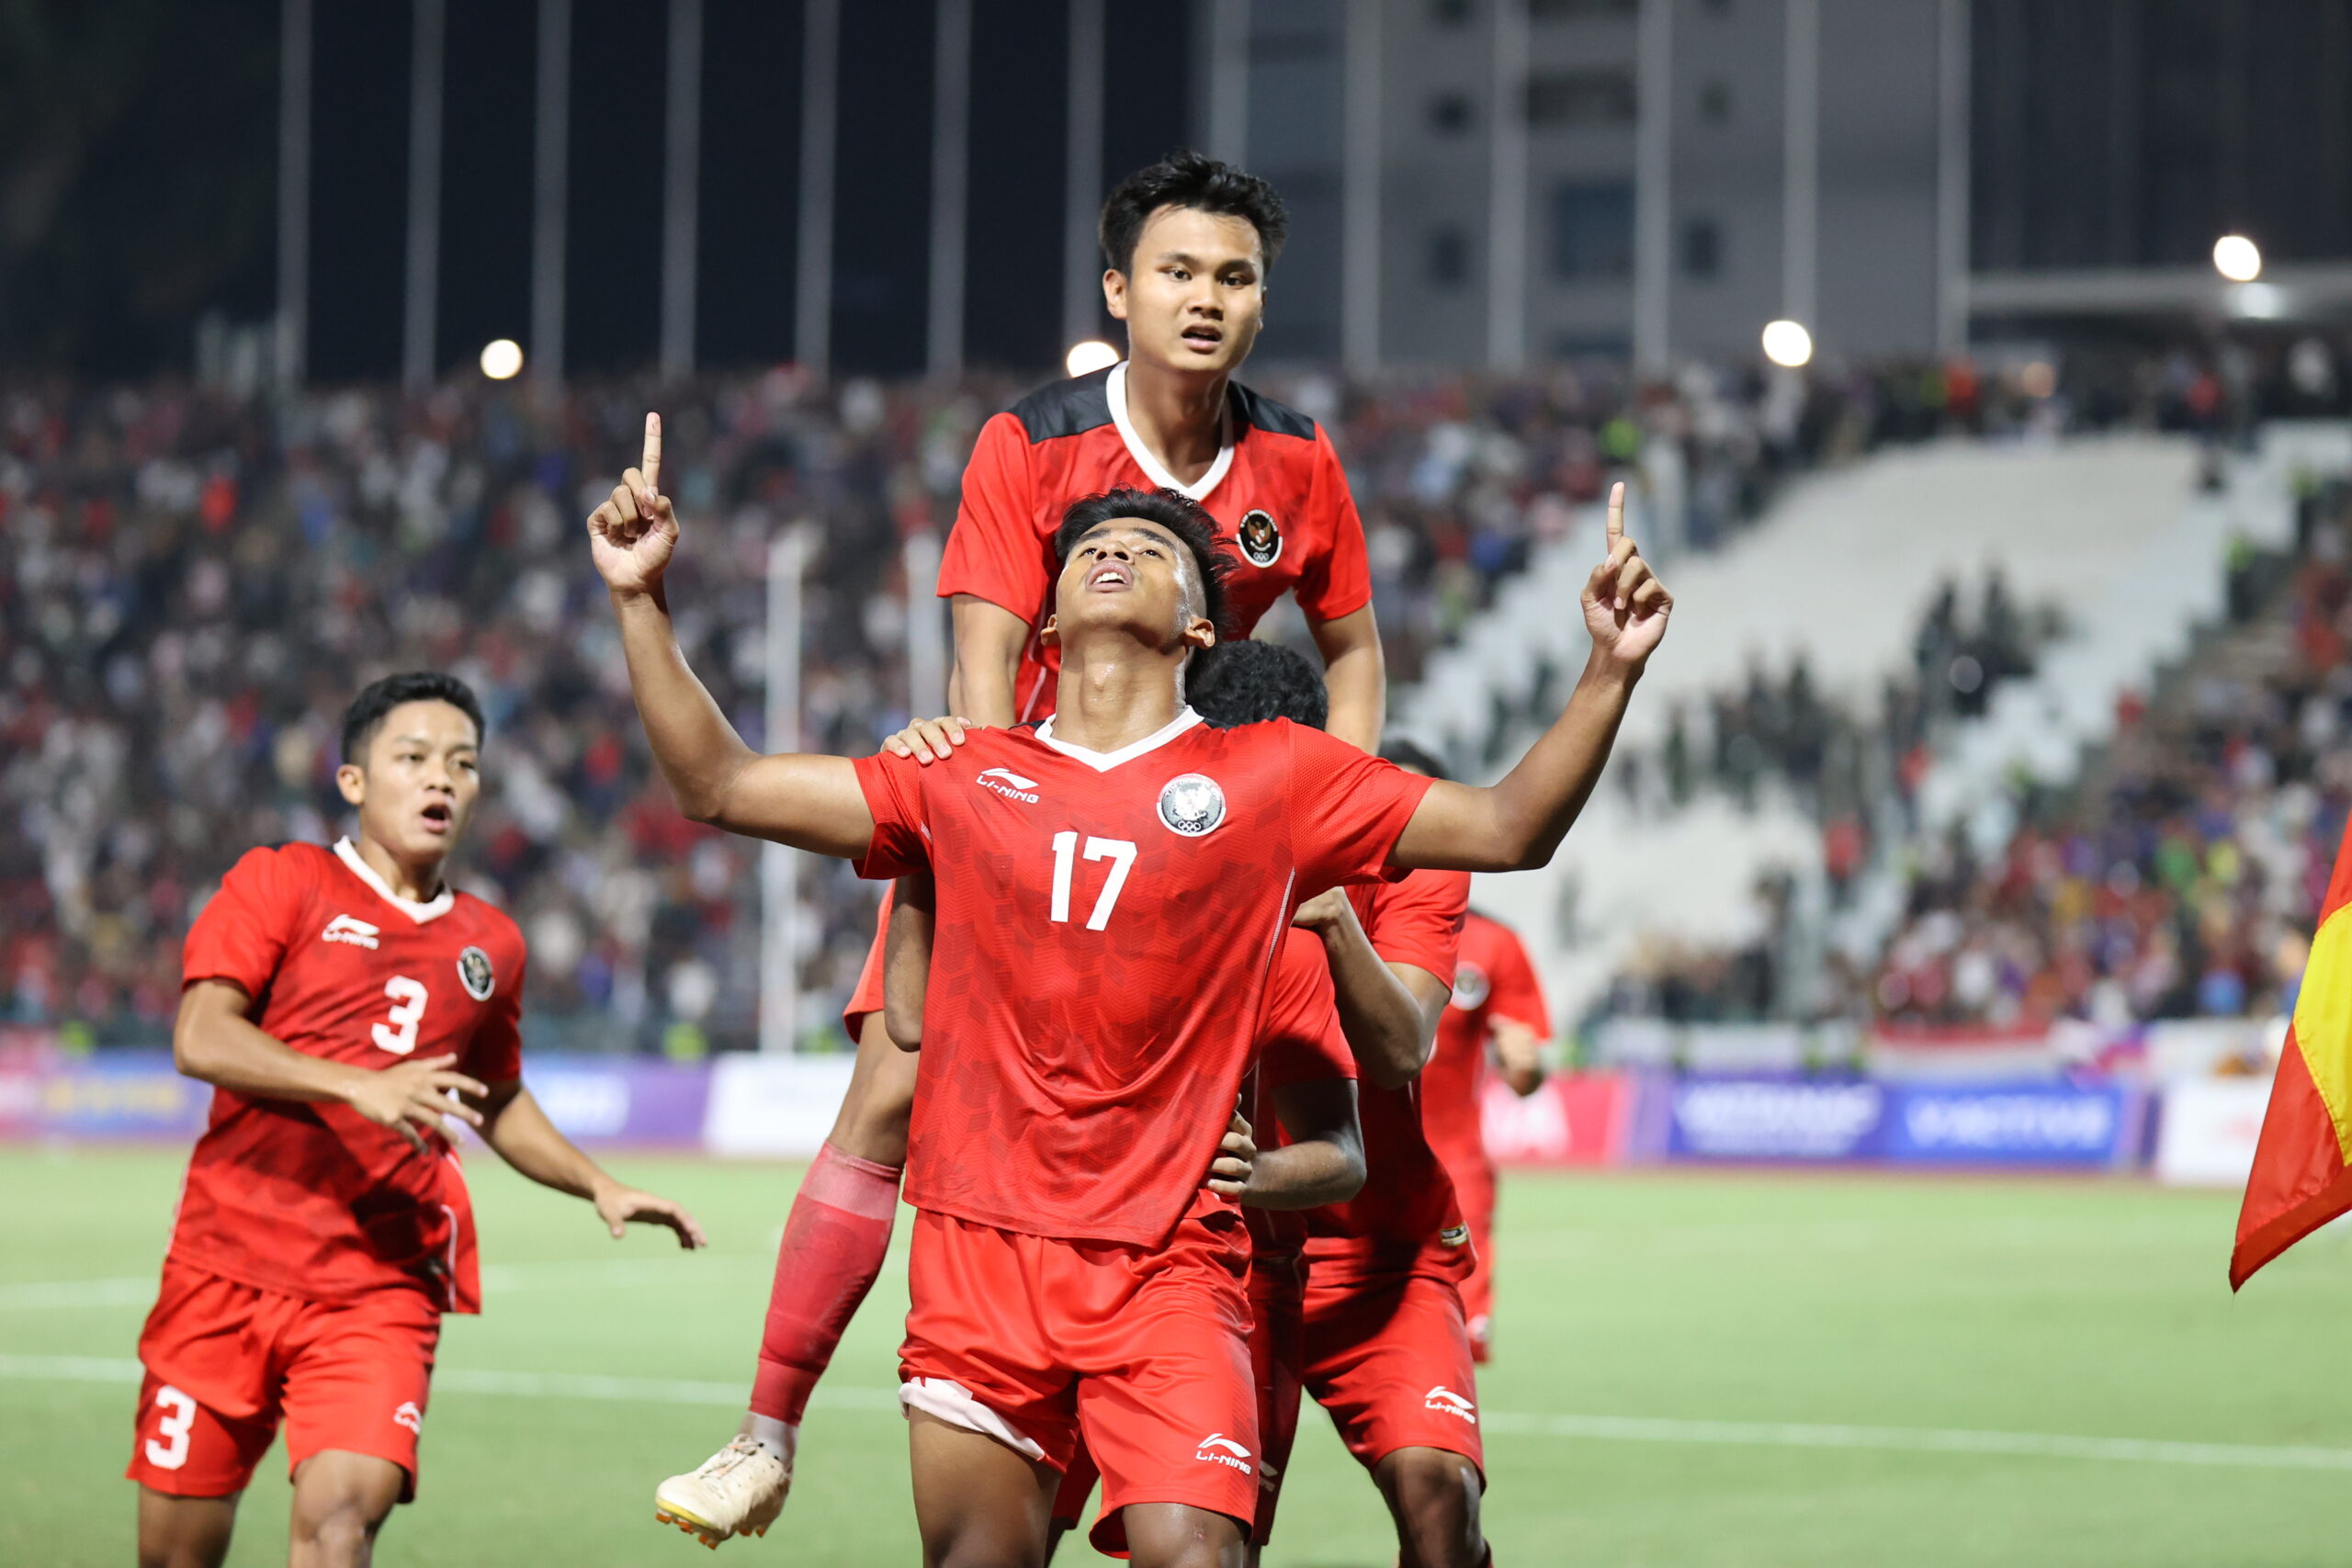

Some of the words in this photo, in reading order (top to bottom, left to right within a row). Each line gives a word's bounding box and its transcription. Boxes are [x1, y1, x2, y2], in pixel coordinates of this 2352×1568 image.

[976, 774, 1040, 804] LI-NING
[1050, 830, 1138, 931] 17
[371, 975, 429, 1055] 3
[145, 1384, 198, 1470] 3
[1195, 1450, 1252, 1475] LI-NING
